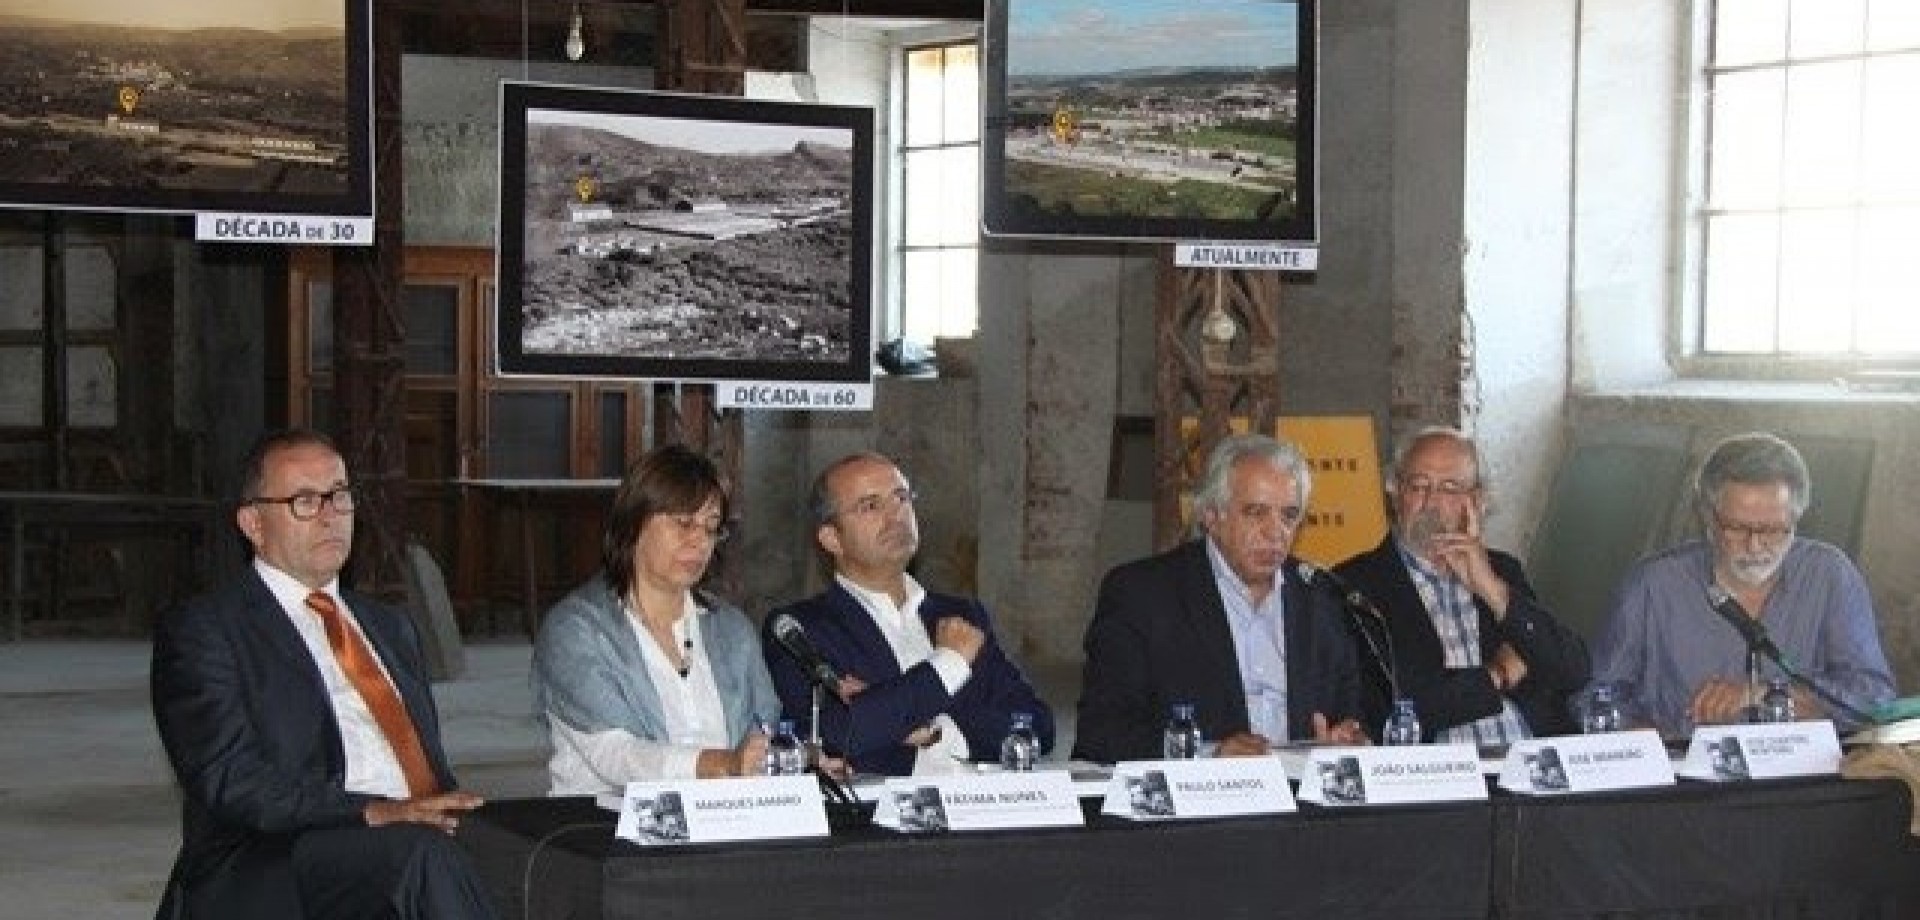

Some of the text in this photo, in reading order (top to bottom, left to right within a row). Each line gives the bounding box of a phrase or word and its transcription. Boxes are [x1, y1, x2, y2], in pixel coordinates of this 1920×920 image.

[215, 216, 301, 238] DÉCADA
[330, 221, 355, 241] 30
[1190, 247, 1301, 267] ATUALMENTE
[734, 385, 811, 406] DÉCADA
[833, 388, 857, 406] 60
[695, 794, 802, 810] MARQUES AMARO
